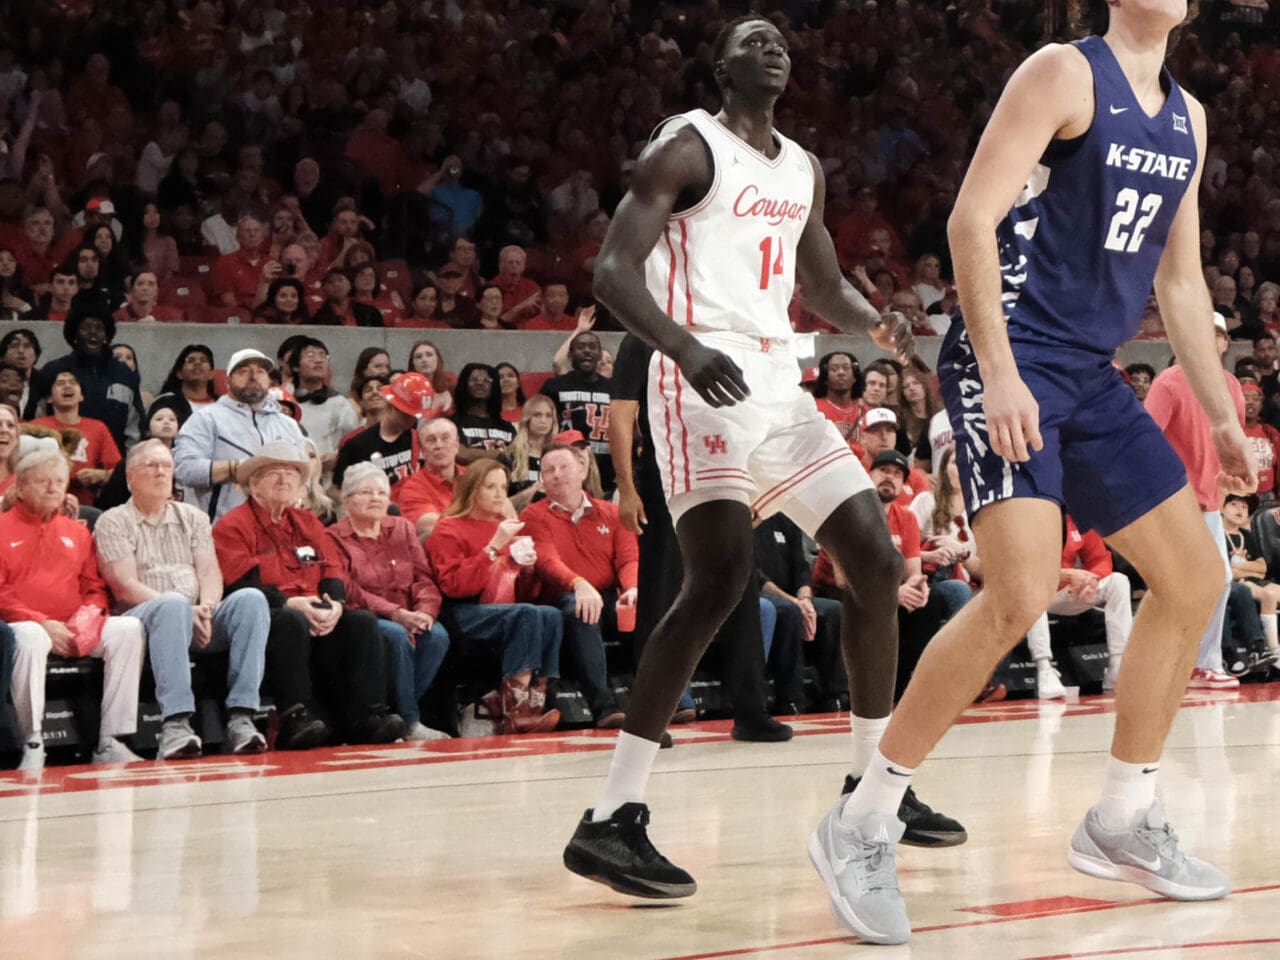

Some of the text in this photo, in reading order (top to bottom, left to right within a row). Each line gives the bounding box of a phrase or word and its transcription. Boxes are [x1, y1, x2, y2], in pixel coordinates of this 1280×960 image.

[1105, 142, 1191, 182] K-STATE
[733, 184, 806, 226] Cougar
[1104, 187, 1163, 254] 22
[703, 434, 727, 455] UH
